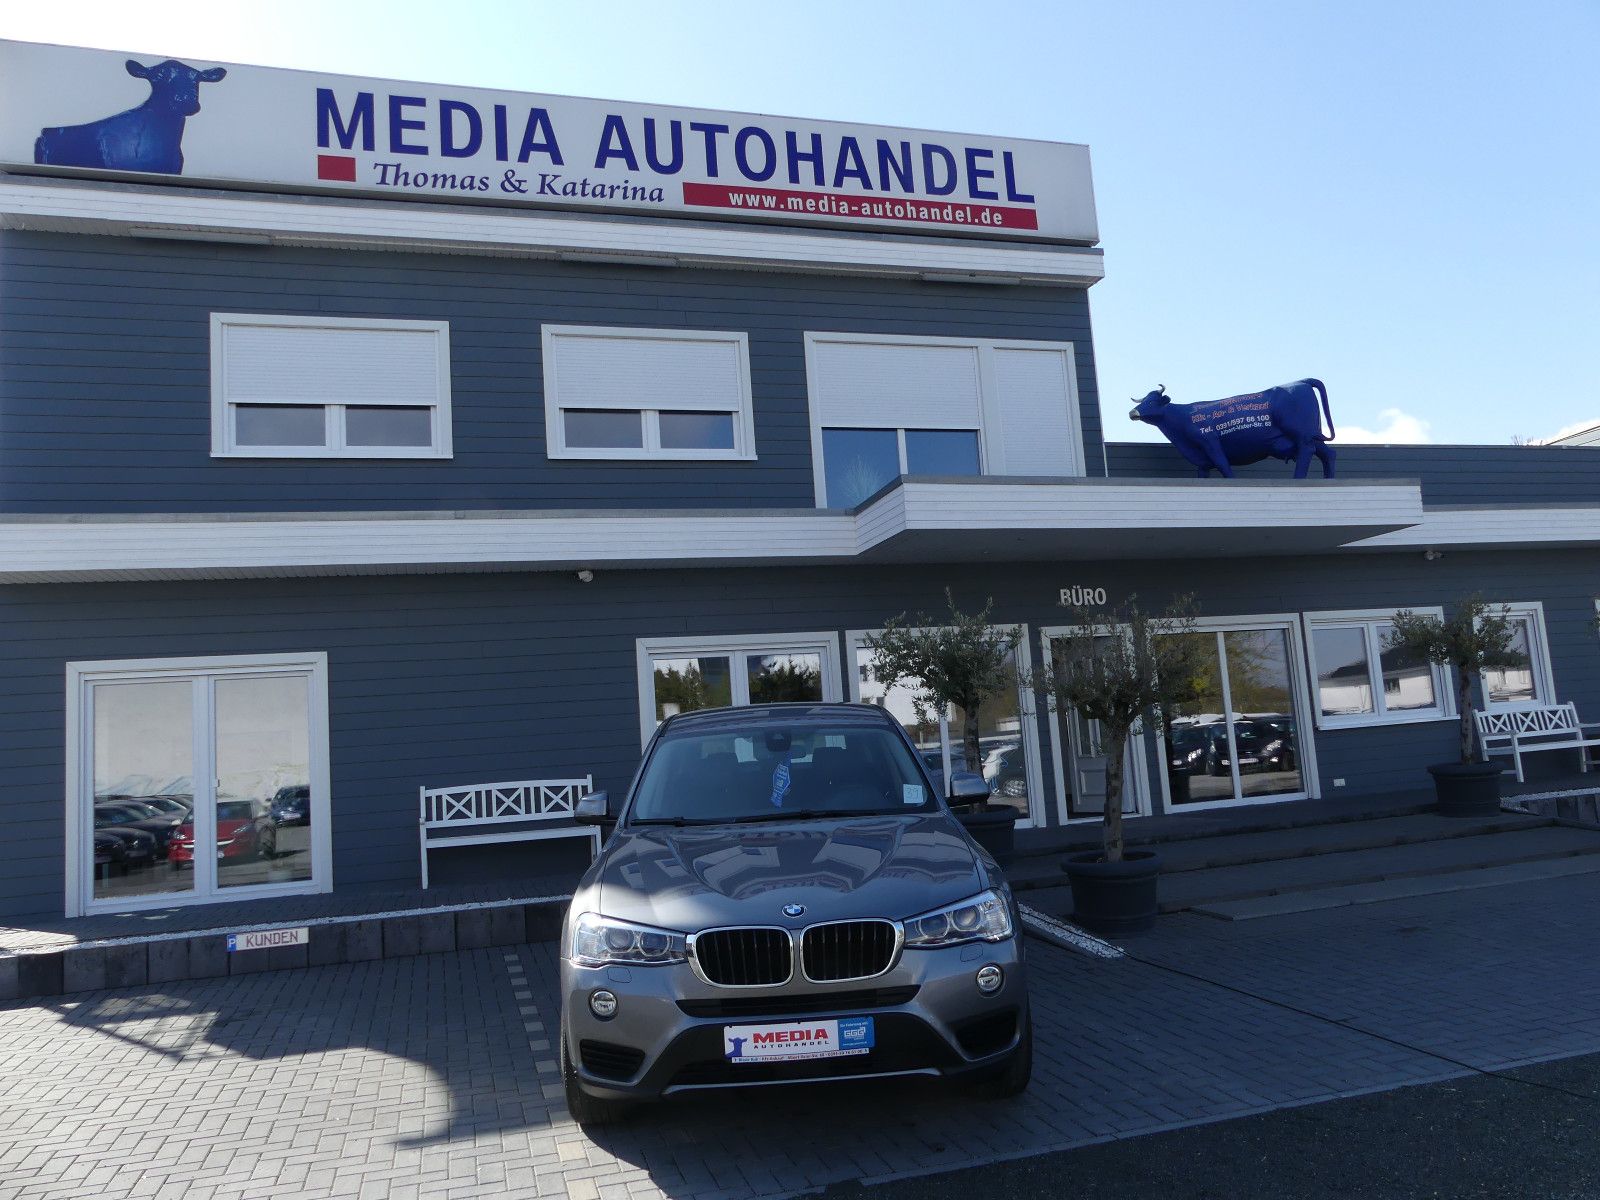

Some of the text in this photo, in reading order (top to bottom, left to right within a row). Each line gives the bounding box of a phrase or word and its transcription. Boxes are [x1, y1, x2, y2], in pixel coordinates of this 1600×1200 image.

[316, 87, 1035, 204] MEDIA AUTOHANDEL
[372, 162, 665, 203] Thomas & Katarina
[728, 190, 1003, 226] www.media-autohandel.de
[1060, 585, 1107, 606] BÜRO
[228, 931, 298, 948] P KUNDEN
[753, 1028, 829, 1044] MEDIA
[753, 1040, 830, 1049] AUTOHANDEL
